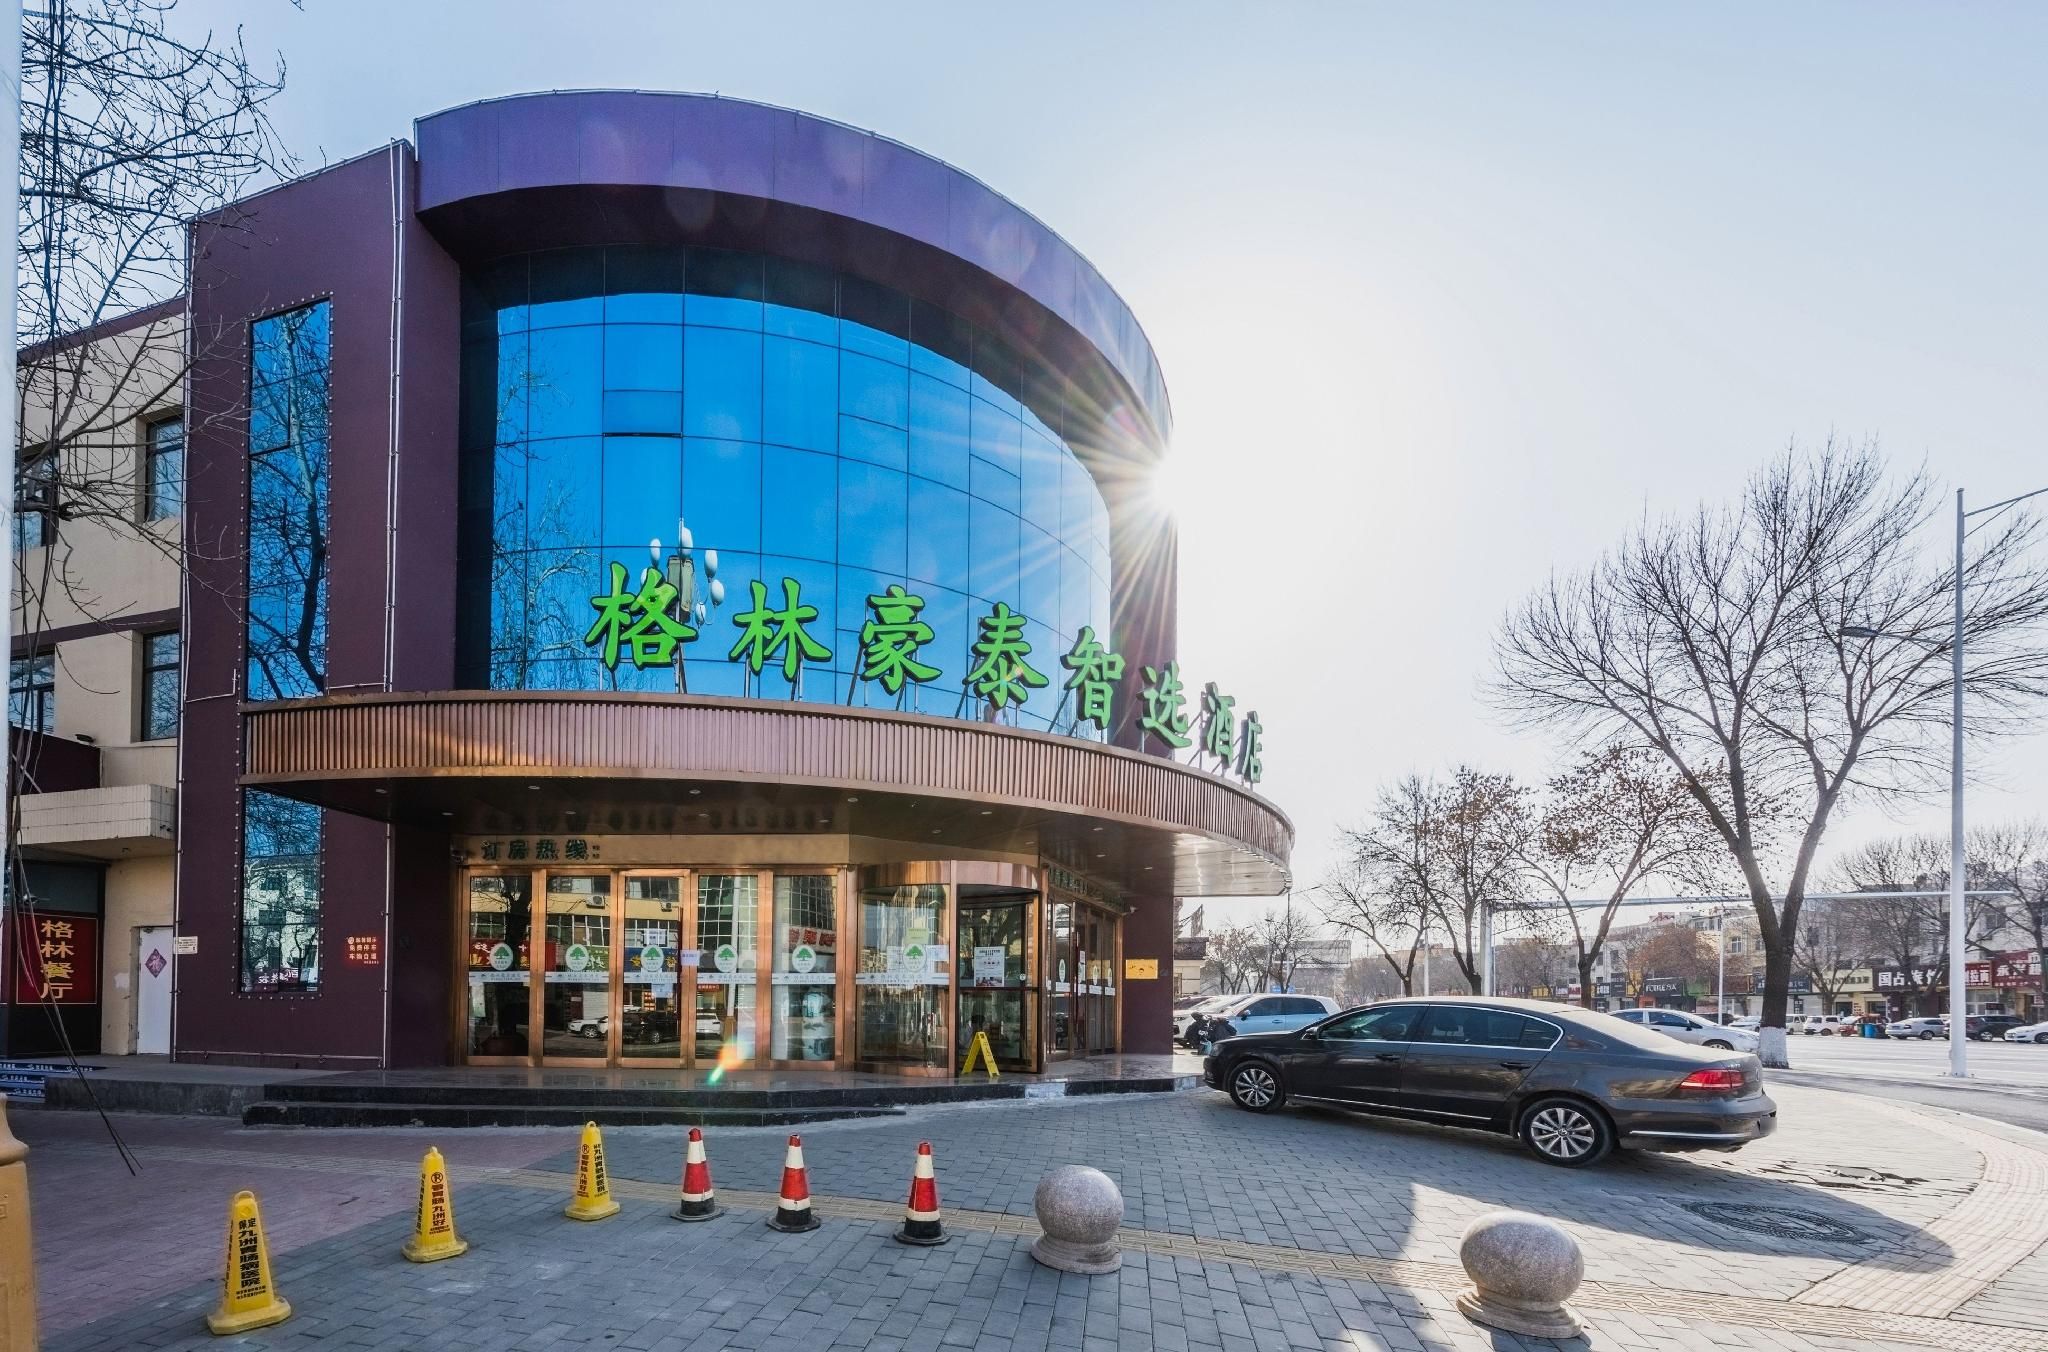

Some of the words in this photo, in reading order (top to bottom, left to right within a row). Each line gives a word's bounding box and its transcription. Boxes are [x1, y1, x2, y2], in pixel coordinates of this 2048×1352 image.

[584, 560, 1264, 784] 格林豪泰智选酒店
[40, 919, 75, 1000] 格林餐厅
